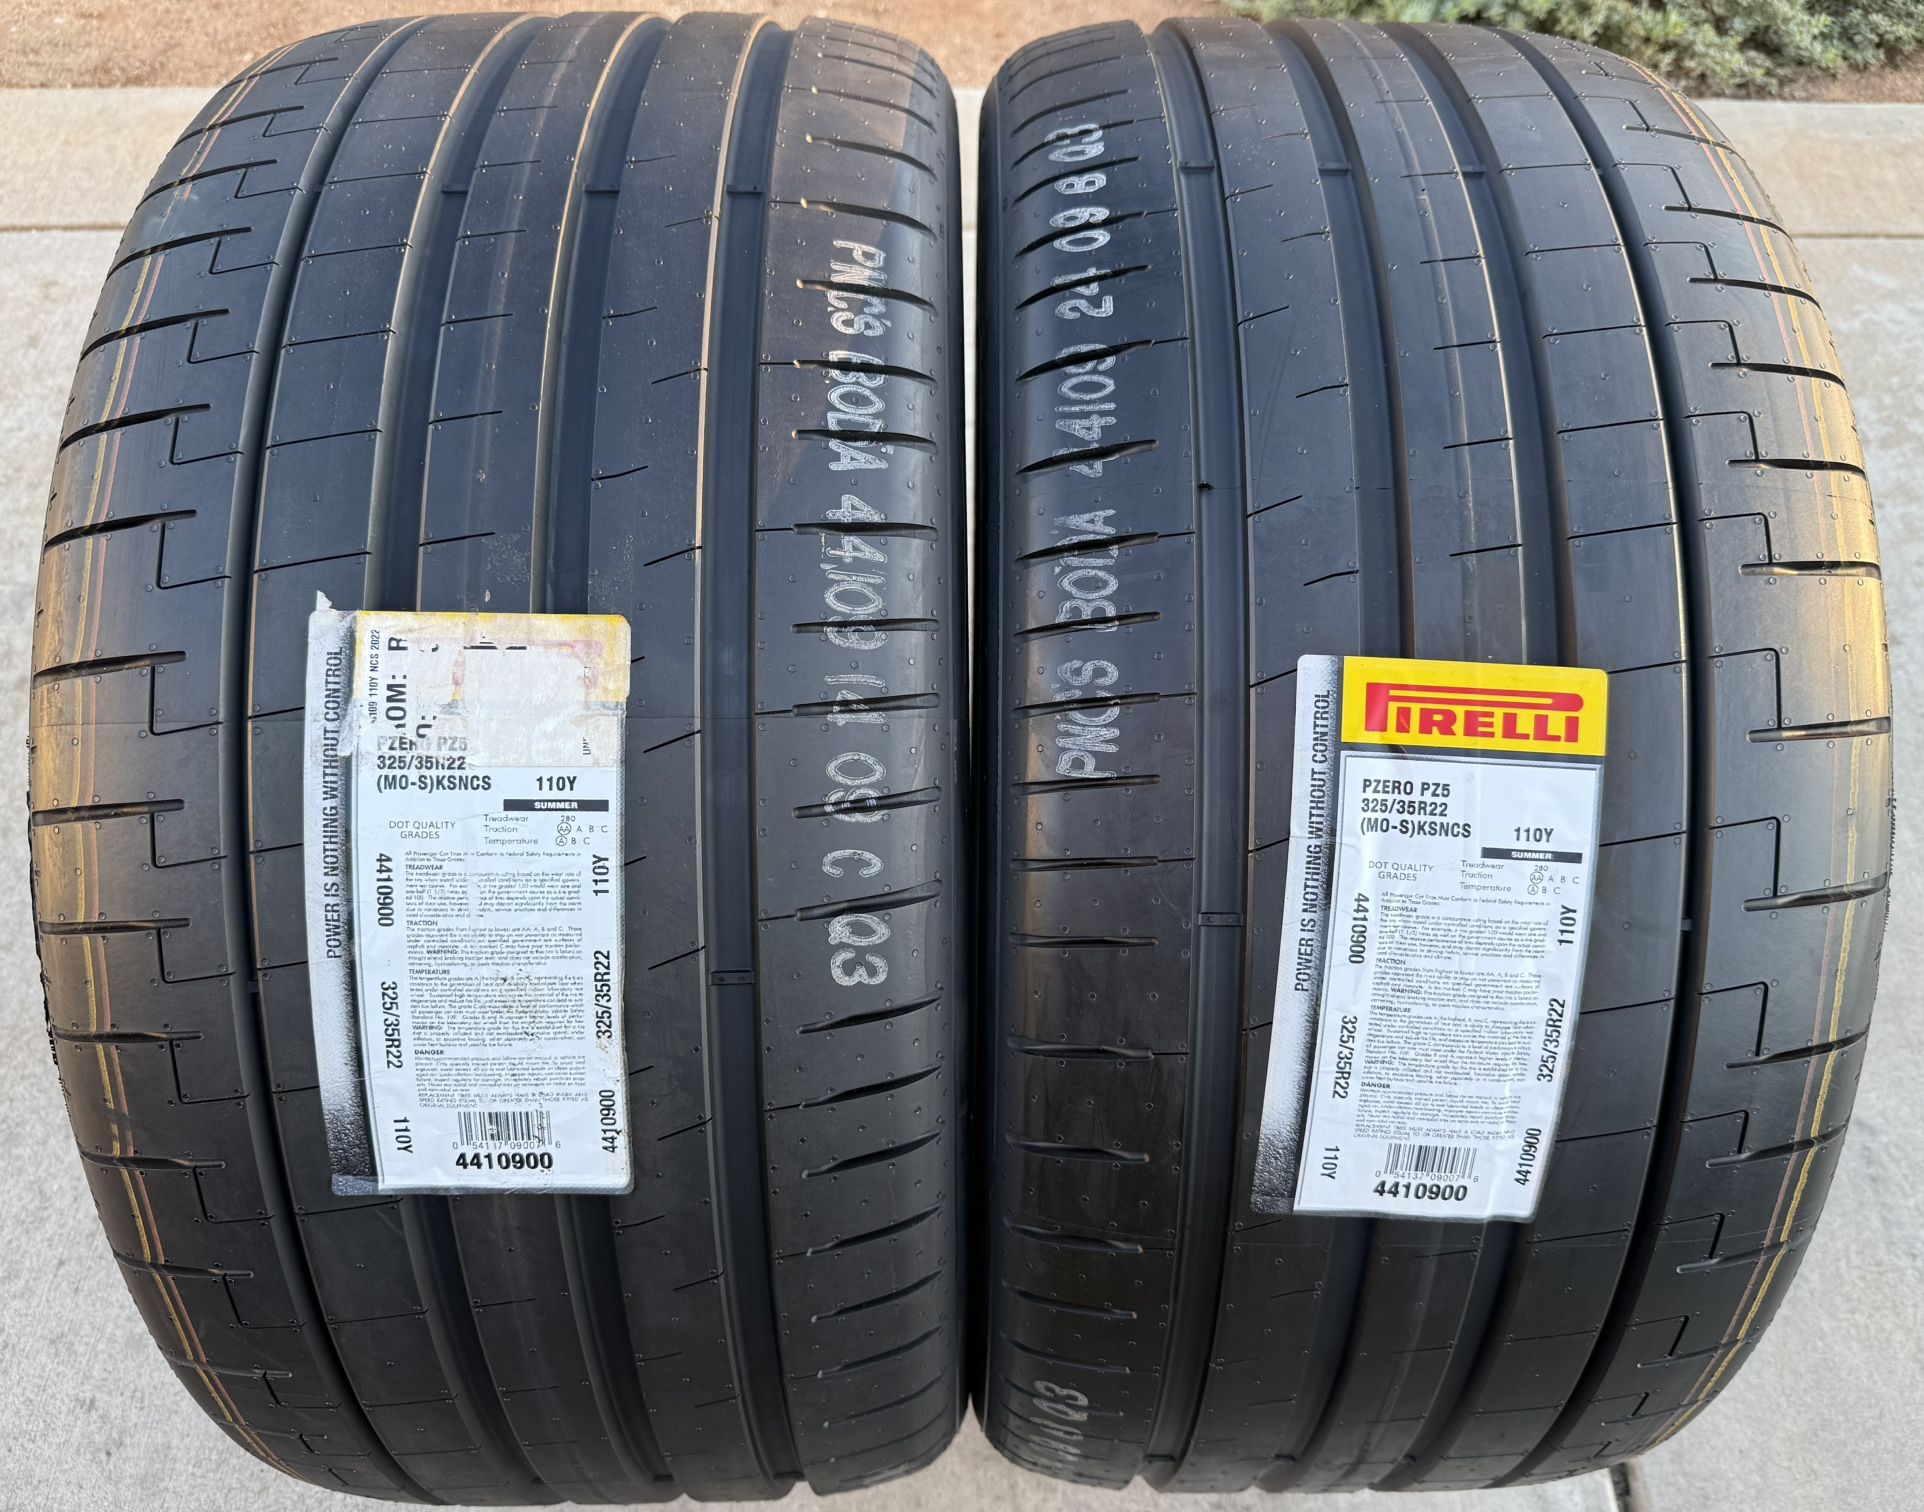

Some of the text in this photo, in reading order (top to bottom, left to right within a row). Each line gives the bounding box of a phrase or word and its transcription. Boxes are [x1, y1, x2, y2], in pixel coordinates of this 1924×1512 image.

[370, 629, 380, 650] 2022
[369, 654, 379, 672] NCS
[369, 676, 378, 697] 110Y
[1364, 682, 1584, 743] PIRELLI
[377, 774, 577, 793] (MO-S)KSNCS 110Y
[1362, 778, 1450, 798] PZERO PZ5
[322, 646, 343, 959] POWER IS NOTHING WITHOUT CONTROL
[534, 801, 578, 809] SUMMER
[1361, 799, 1448, 817] 325/35R22
[389, 820, 456, 829] DOT QUALITY
[484, 814, 529, 822] Treadwear
[484, 824, 518, 833] Traction
[601, 825, 608, 833] C
[400, 831, 440, 840] GRADES
[1360, 817, 1554, 842] (MO-S)KSNCS 110Y
[484, 837, 539, 846] Temperature
[1294, 690, 1330, 992] POWER IS NOTHING WITHOUT CONTROL
[821, 848, 884, 878] C
[1461, 860, 1504, 869] Treadwear
[1511, 851, 1553, 860] SUMMER
[593, 854, 609, 896] 110Y
[1368, 861, 1433, 872] DOT QUALITY
[1378, 871, 1417, 881] GRADES
[1460, 870, 1493, 879] Traction
[1572, 876, 1580, 884] C
[376, 853, 394, 927] 4410900
[1460, 882, 1511, 892] Temperature
[1349, 893, 1369, 964] 4410900
[1557, 904, 1577, 946] 110Y
[594, 950, 612, 1039] 325/35R22
[381, 980, 403, 1069] 325/35R22
[1536, 998, 1566, 1083] 325/35R22
[1333, 1015, 1357, 1099] 325/35R22
[599, 1090, 618, 1153] 4410900
[393, 1116, 413, 1154] 110Y
[456, 1152, 553, 1170] 4410900
[1320, 1145, 1340, 1180] 110Y
[1514, 1128, 1542, 1186] 4410900
[1394, 1172, 1424, 1180] 54137
[1430, 1173, 1460, 1182] 09007
[1373, 1180, 1468, 1201] 4410900
